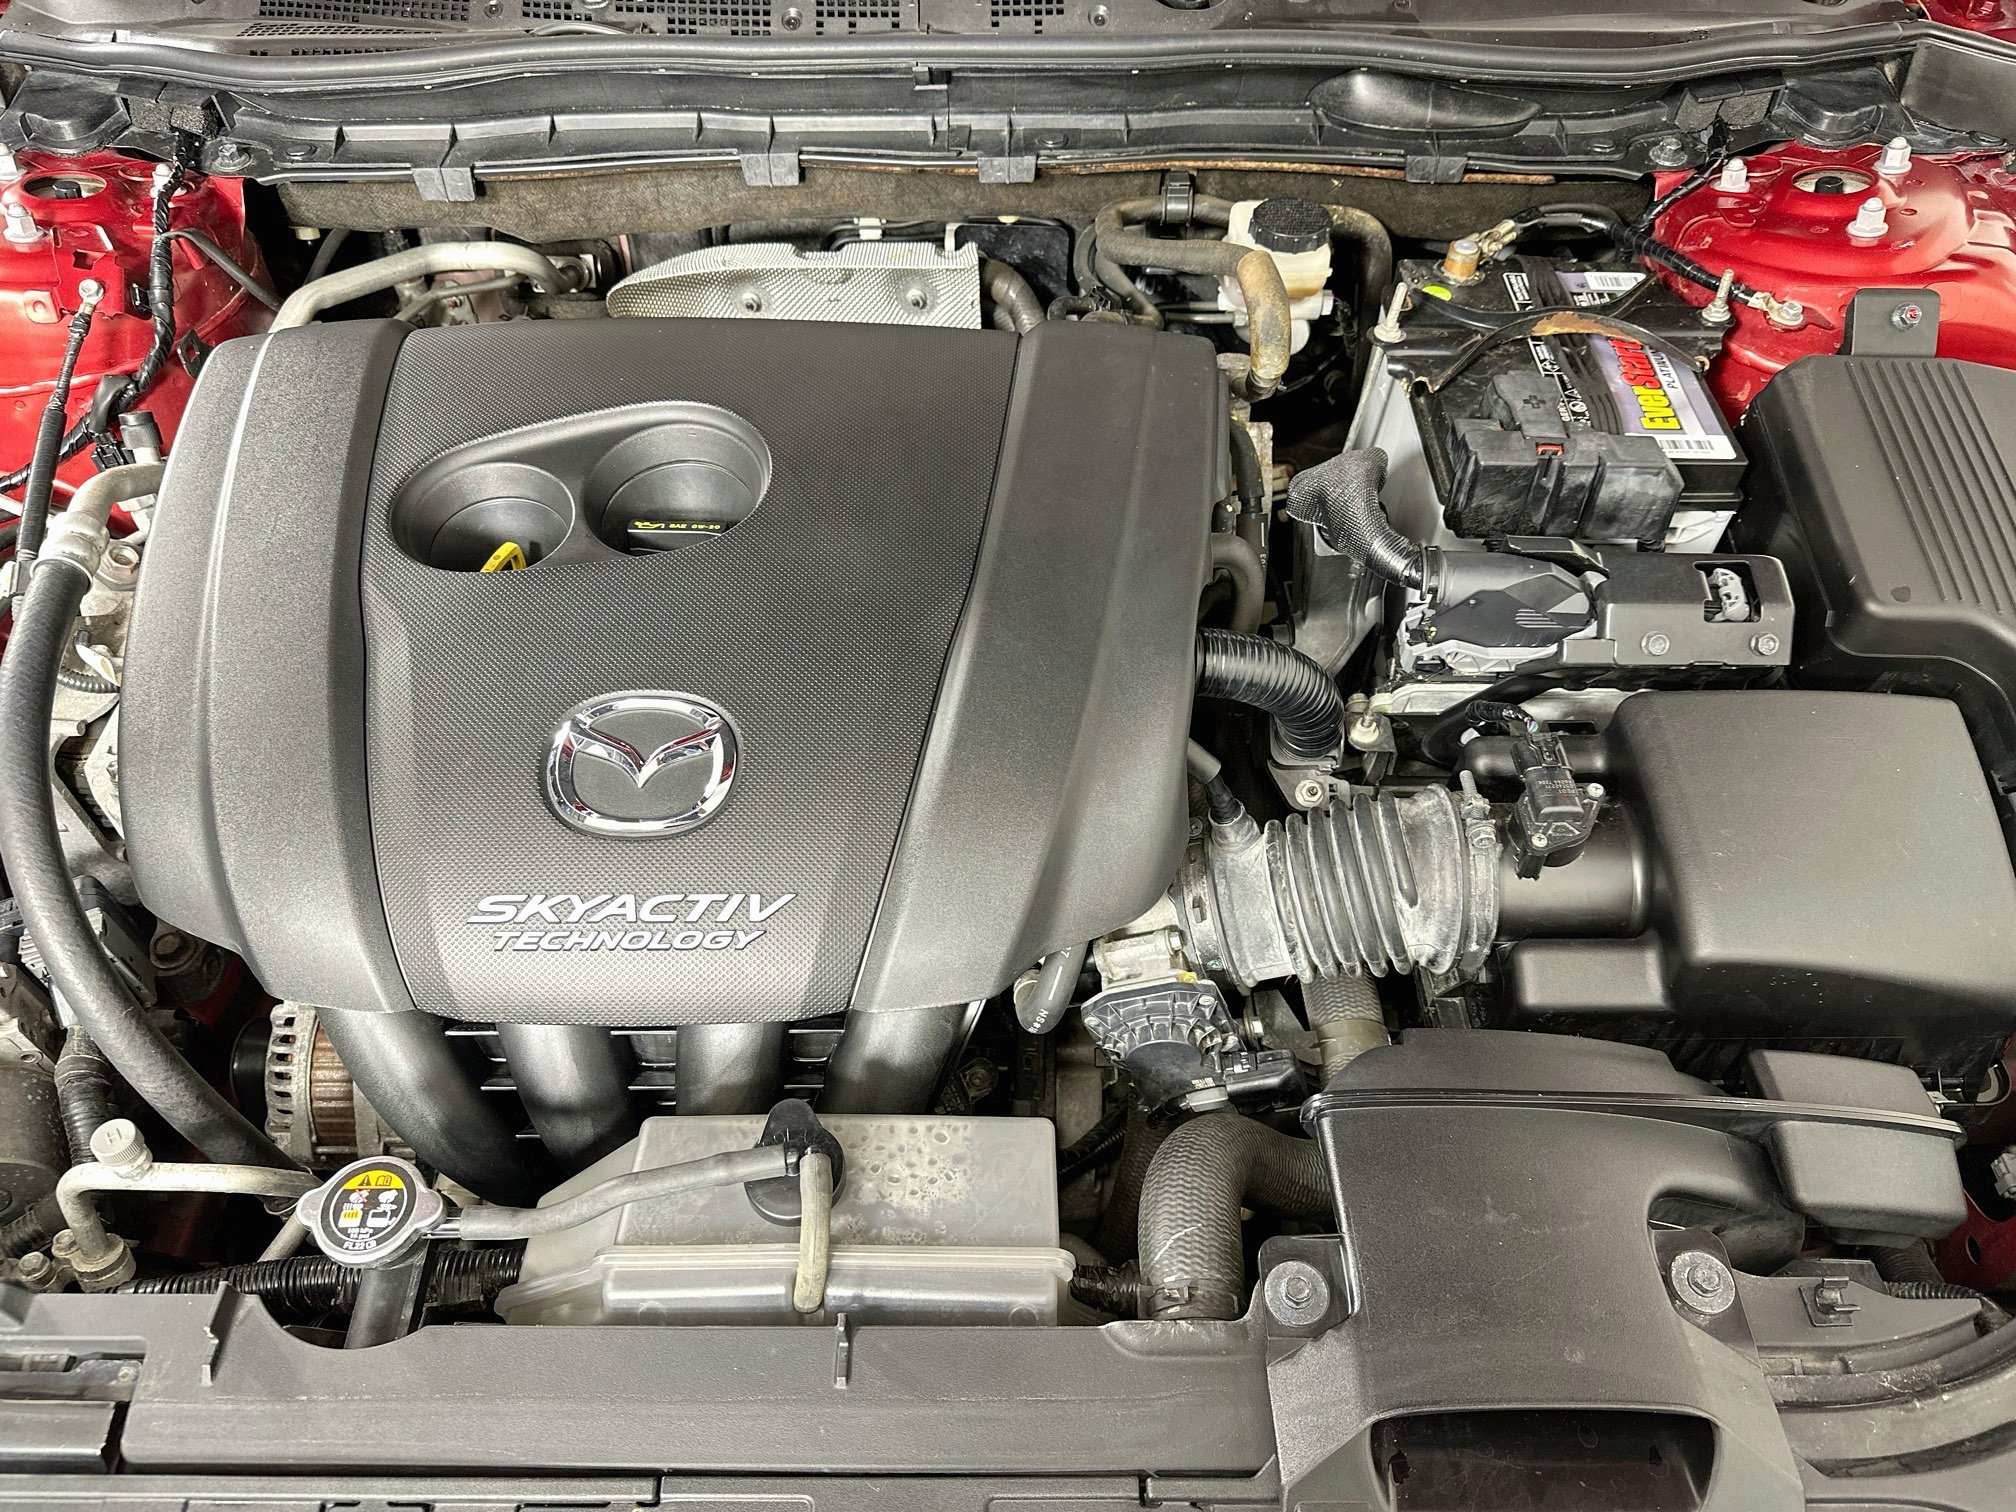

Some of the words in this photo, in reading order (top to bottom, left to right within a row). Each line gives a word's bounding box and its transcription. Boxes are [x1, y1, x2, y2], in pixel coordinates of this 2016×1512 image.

[1606, 337, 1683, 430] EverStart
[1650, 350, 1679, 389] PLATINU
[467, 894, 797, 923] SKYACTIV
[494, 930, 767, 951] TECHNOLOGY
